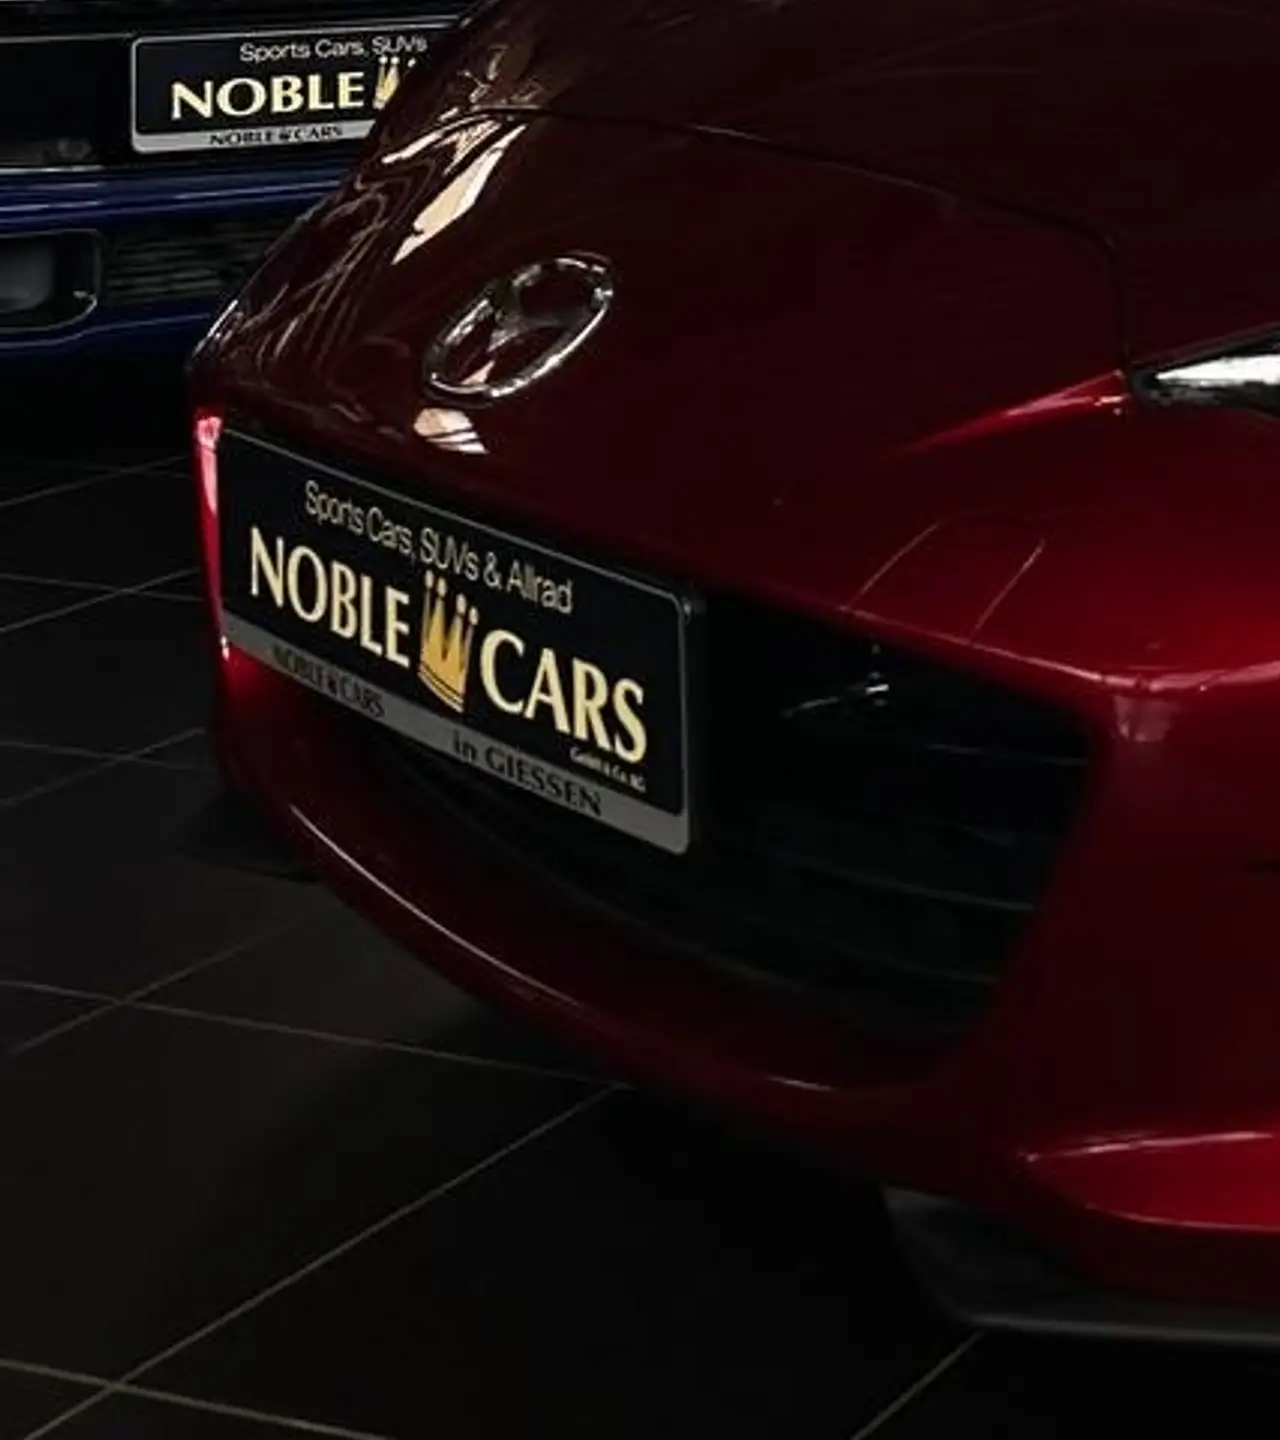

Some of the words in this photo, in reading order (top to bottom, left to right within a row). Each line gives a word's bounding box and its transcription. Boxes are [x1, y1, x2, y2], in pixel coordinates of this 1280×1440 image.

[240, 42, 311, 64] Sports
[372, 35, 427, 56] SUVs
[170, 71, 365, 121] NOBLE
[304, 479, 365, 537] Sports
[419, 526, 479, 582] SUVs
[482, 551, 501, 590] &
[505, 560, 573, 615] Allrad
[250, 525, 410, 669] NOBLE
[479, 629, 647, 763] CARS
[485, 746, 602, 818] GIESSEN
